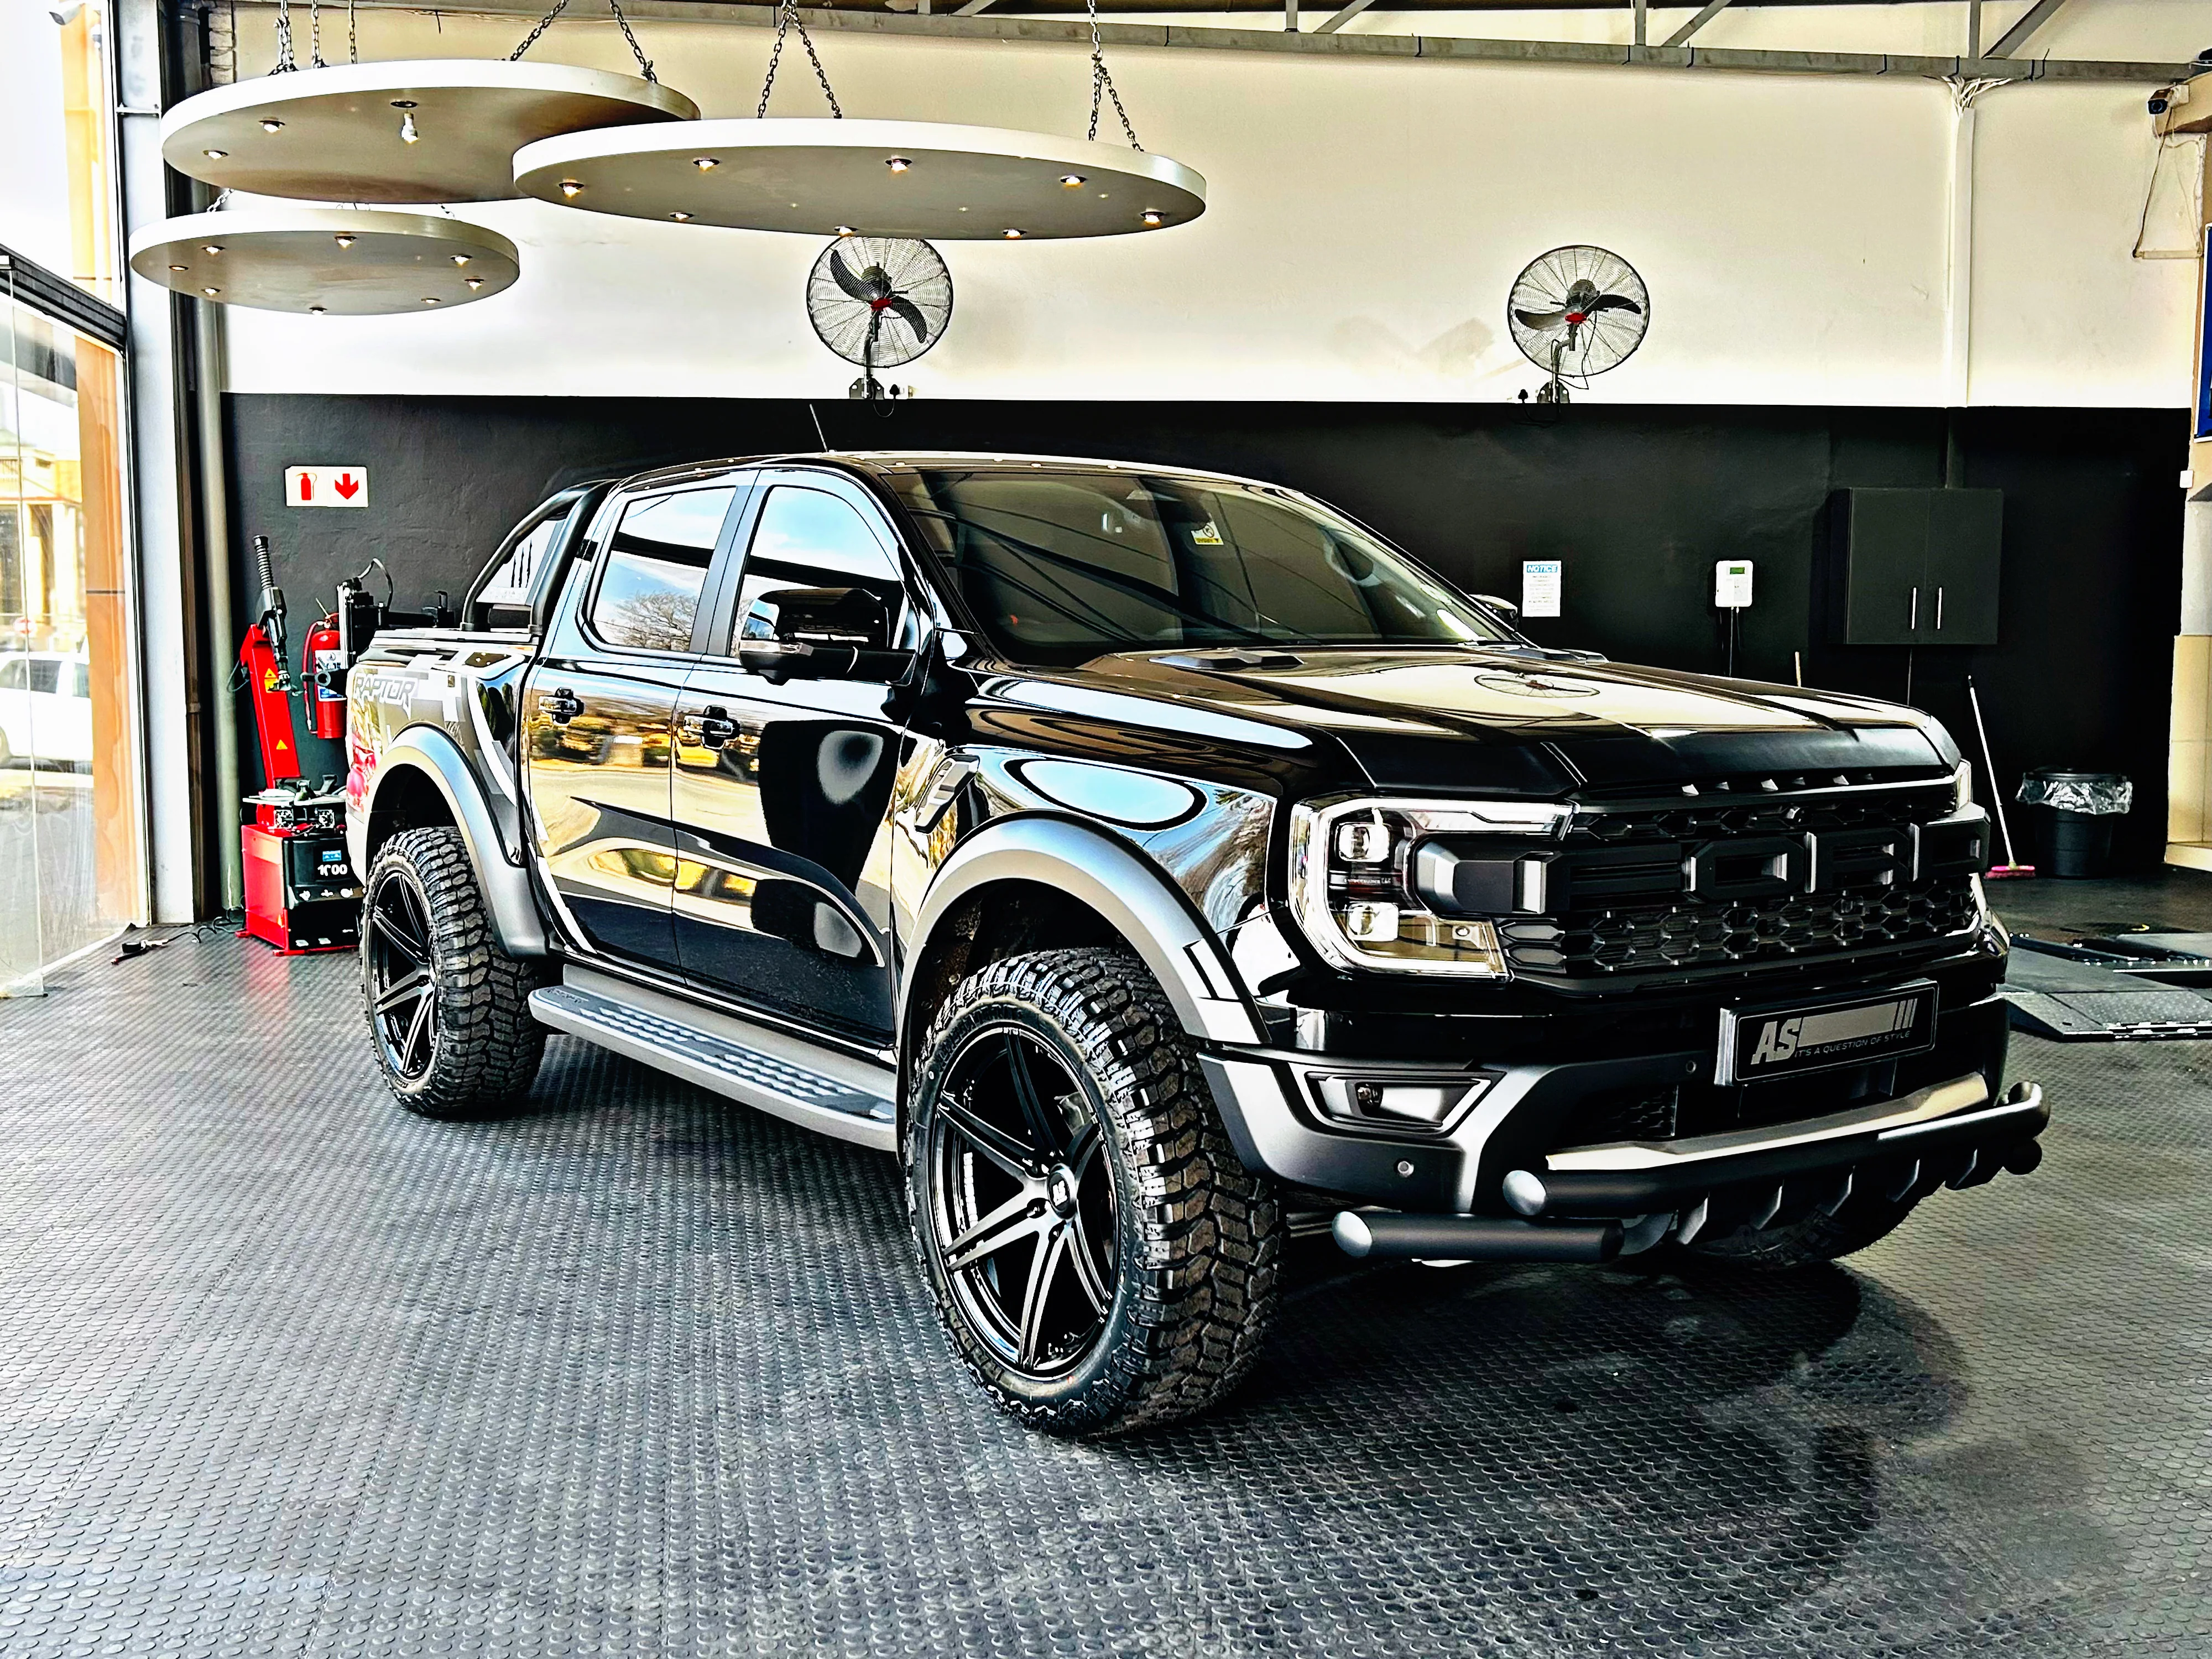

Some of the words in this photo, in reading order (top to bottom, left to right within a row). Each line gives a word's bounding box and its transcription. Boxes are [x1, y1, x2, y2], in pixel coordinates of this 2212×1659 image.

[1527, 565, 1557, 573] NOTICE
[355, 675, 416, 709] RAPTOR
[1520, 810, 1991, 914] FORD
[1814, 1047, 1820, 1055] A
[1823, 1040, 1868, 1054] QUESTION
[1871, 1036, 1882, 1045] OF
[1884, 1030, 1911, 1042] STYLE
